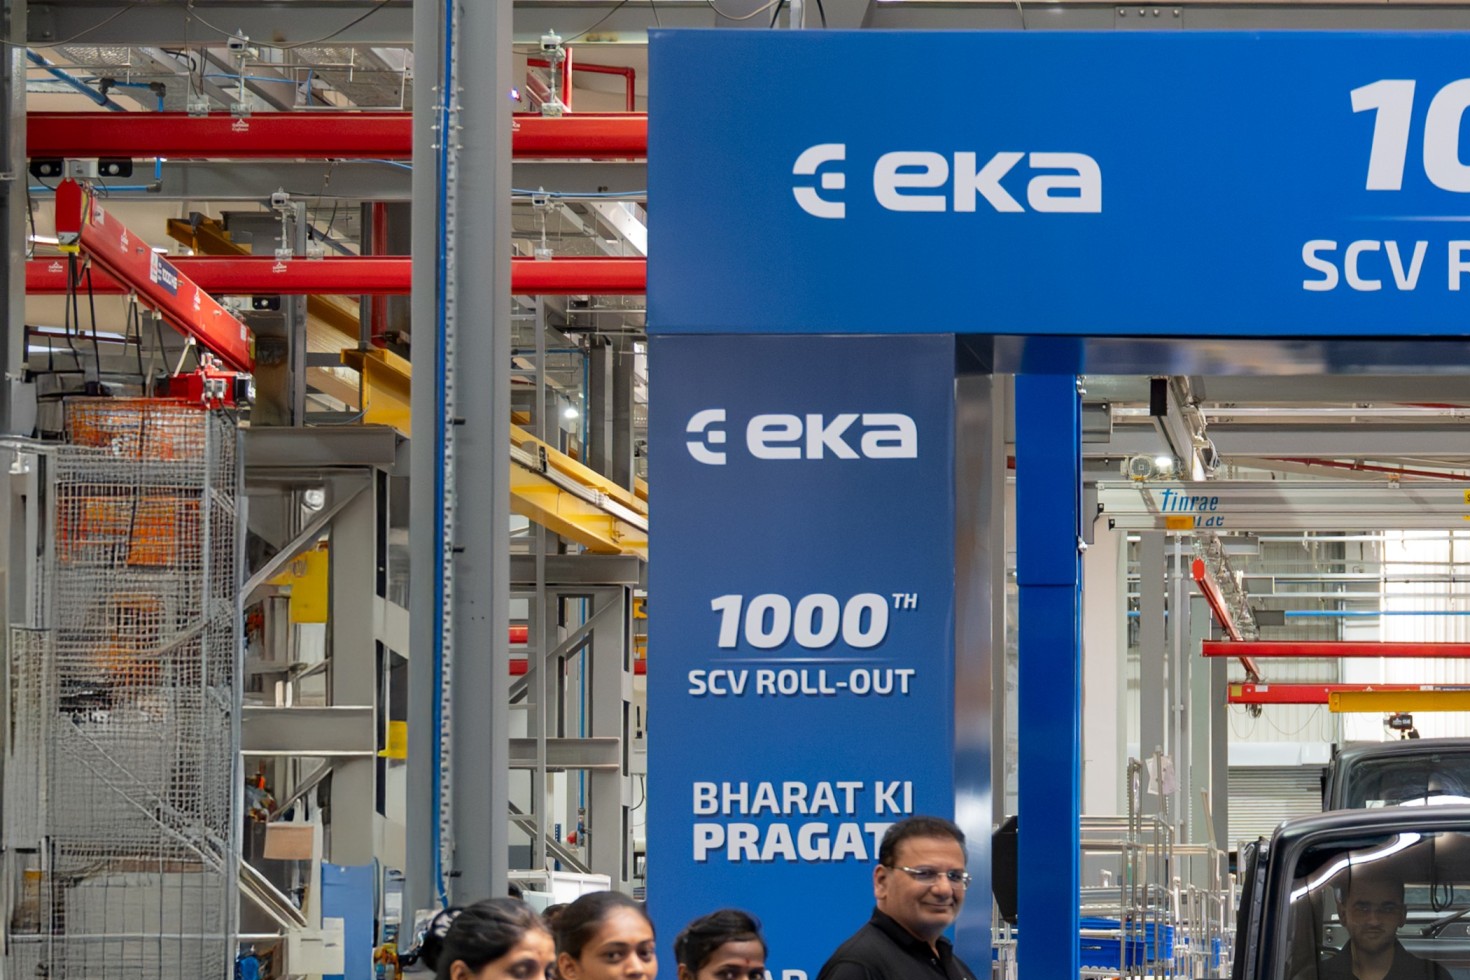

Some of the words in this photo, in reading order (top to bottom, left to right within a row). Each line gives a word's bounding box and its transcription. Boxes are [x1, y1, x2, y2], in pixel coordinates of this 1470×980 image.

[873, 151, 1102, 213] eka
[1301, 239, 1429, 292] SCV
[746, 413, 918, 460] eka
[688, 669, 749, 695] SCV
[756, 668, 915, 695] ROLL-OUT
[693, 781, 864, 815] BHARAT
[874, 780, 913, 814] KI
[693, 822, 897, 861] PRAGAT
